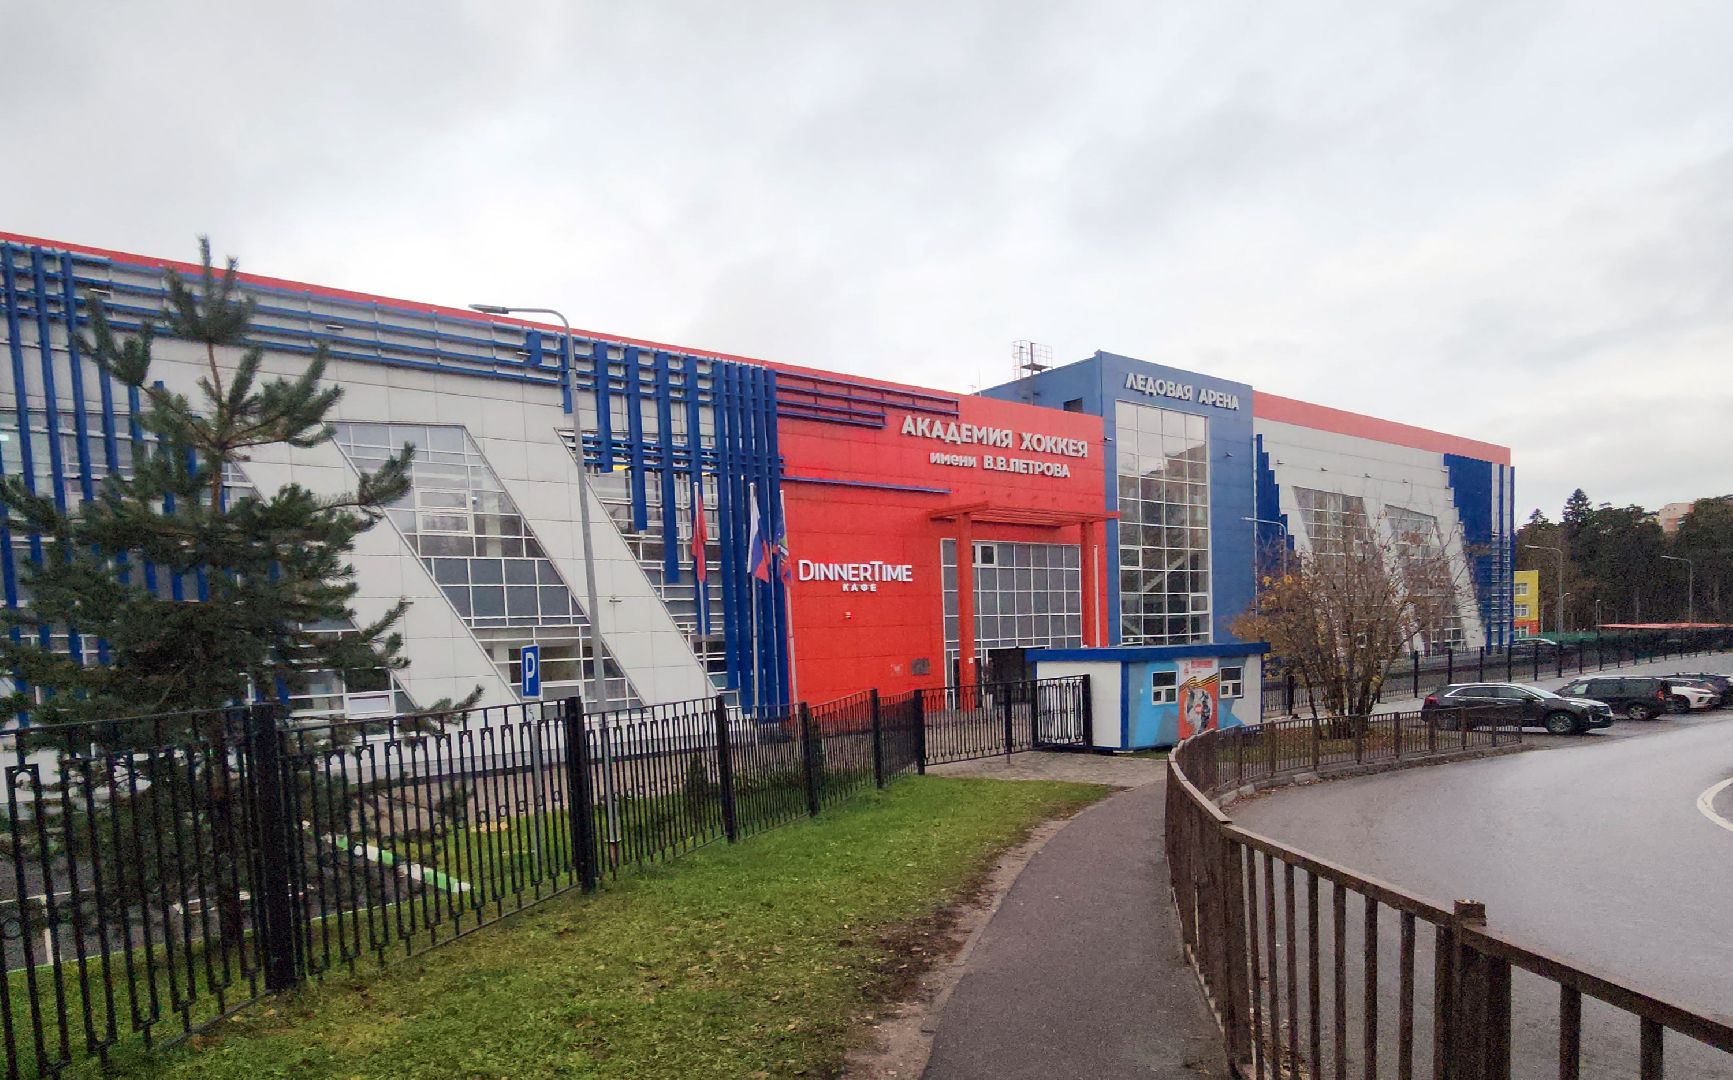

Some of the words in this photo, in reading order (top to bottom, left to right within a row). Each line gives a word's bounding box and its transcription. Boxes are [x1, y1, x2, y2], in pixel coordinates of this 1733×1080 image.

[1125, 372, 1193, 401] ЛЕДОВАЯ
[1198, 388, 1240, 411] АРЕНА
[901, 414, 1013, 449] АКАДЕМИЯ
[1019, 432, 1088, 458] ХОККЕЯ
[929, 452, 977, 468] имени
[983, 455, 1071, 478] В.В.ПЕТРОВА
[842, 583, 877, 592] КАФЕ
[525, 652, 536, 693] P
